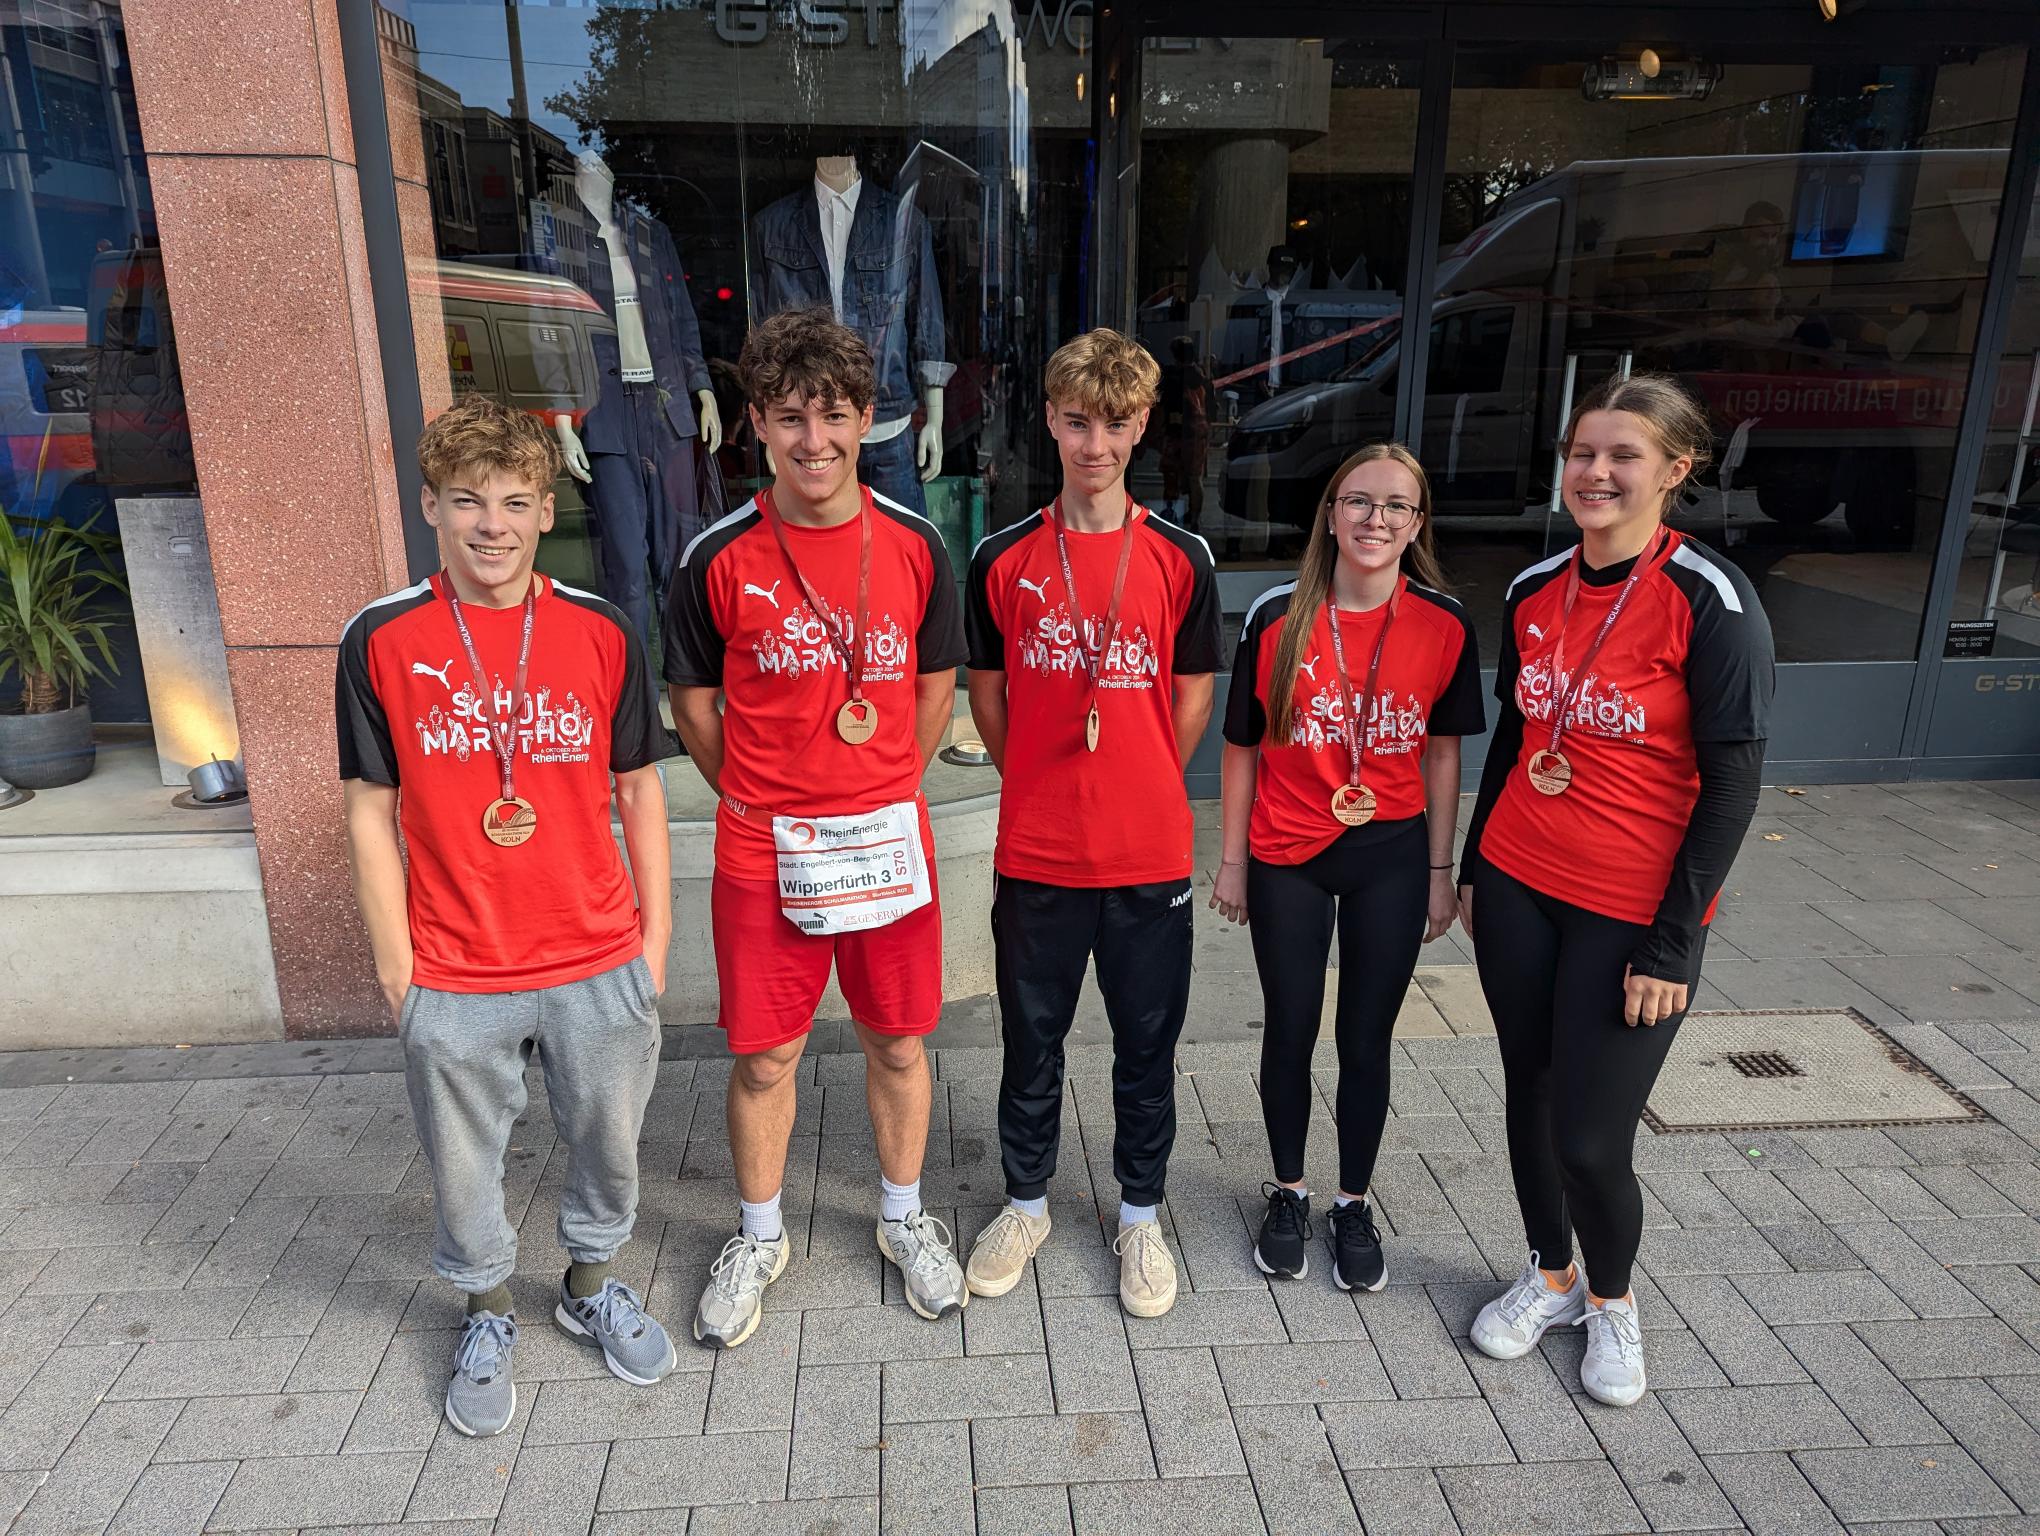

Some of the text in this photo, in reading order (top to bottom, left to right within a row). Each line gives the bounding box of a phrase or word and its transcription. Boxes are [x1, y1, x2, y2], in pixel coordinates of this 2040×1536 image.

[820, 820, 888, 839] RheinEnergie
[779, 861, 799, 869] Städt.
[893, 850, 907, 876] S70
[783, 870, 892, 897] Wipperfürth 3
[798, 920, 824, 930] PUMA
[858, 908, 905, 923] GENERALI
